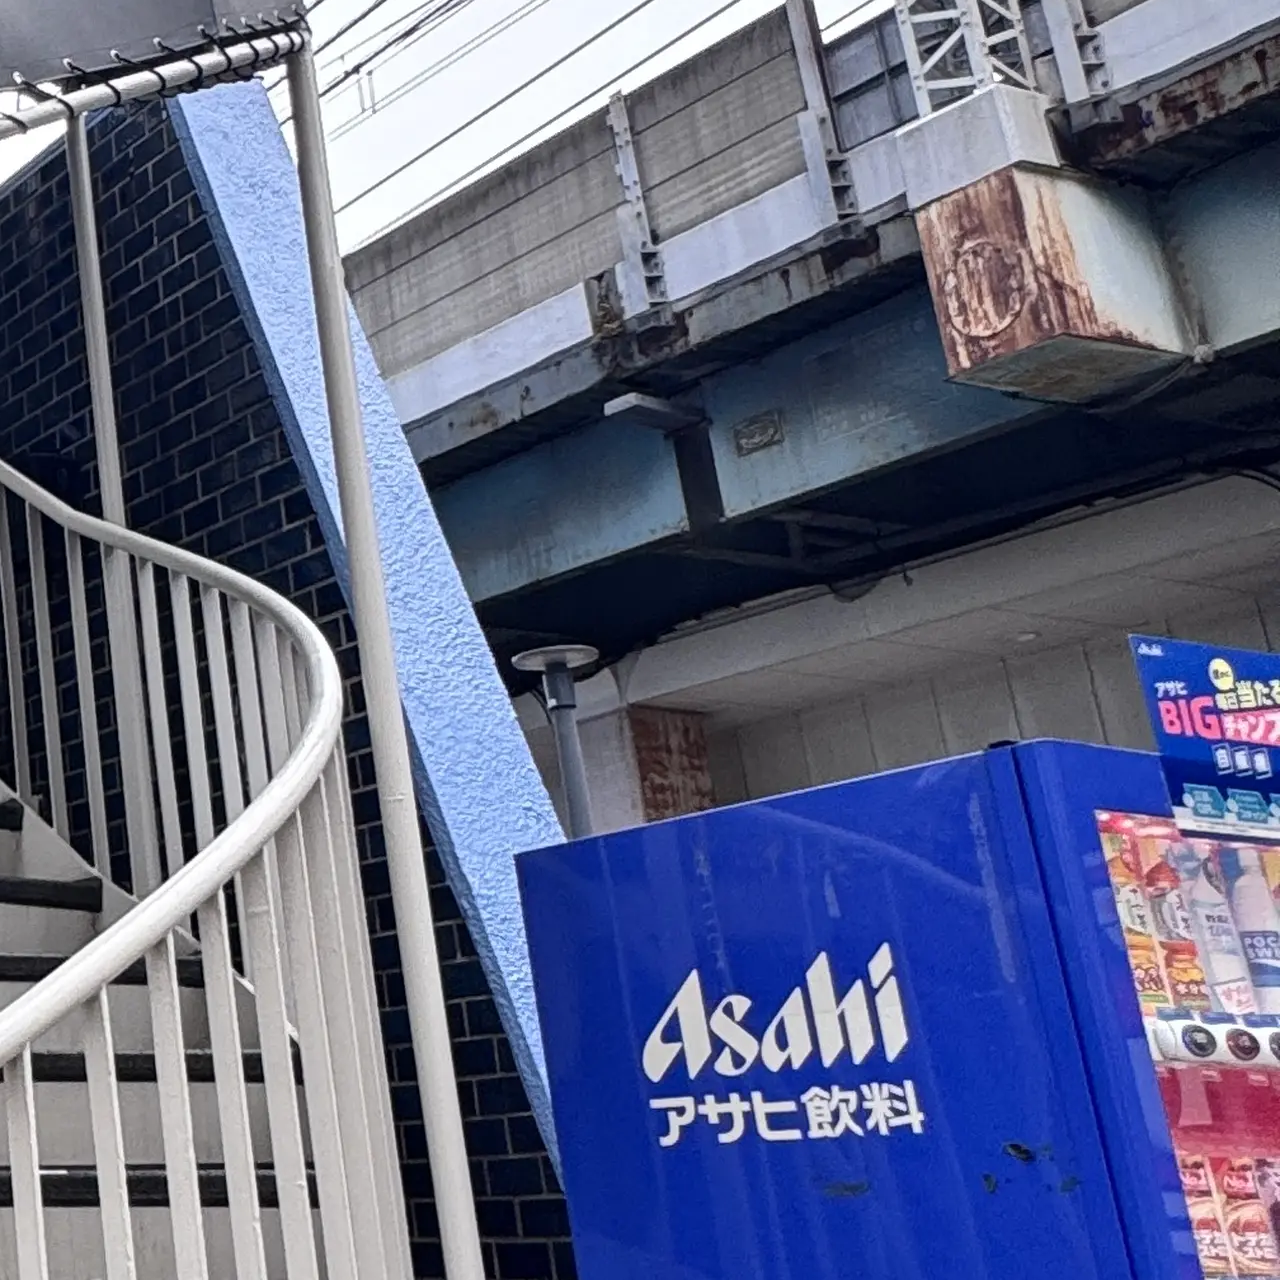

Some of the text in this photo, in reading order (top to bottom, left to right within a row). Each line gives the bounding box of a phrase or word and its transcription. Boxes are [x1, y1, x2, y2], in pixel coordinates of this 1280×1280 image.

[1158, 696, 1221, 740] BIG
[642, 941, 909, 1083] Asahi
[649, 1079, 925, 1147] アサヒ飲料
